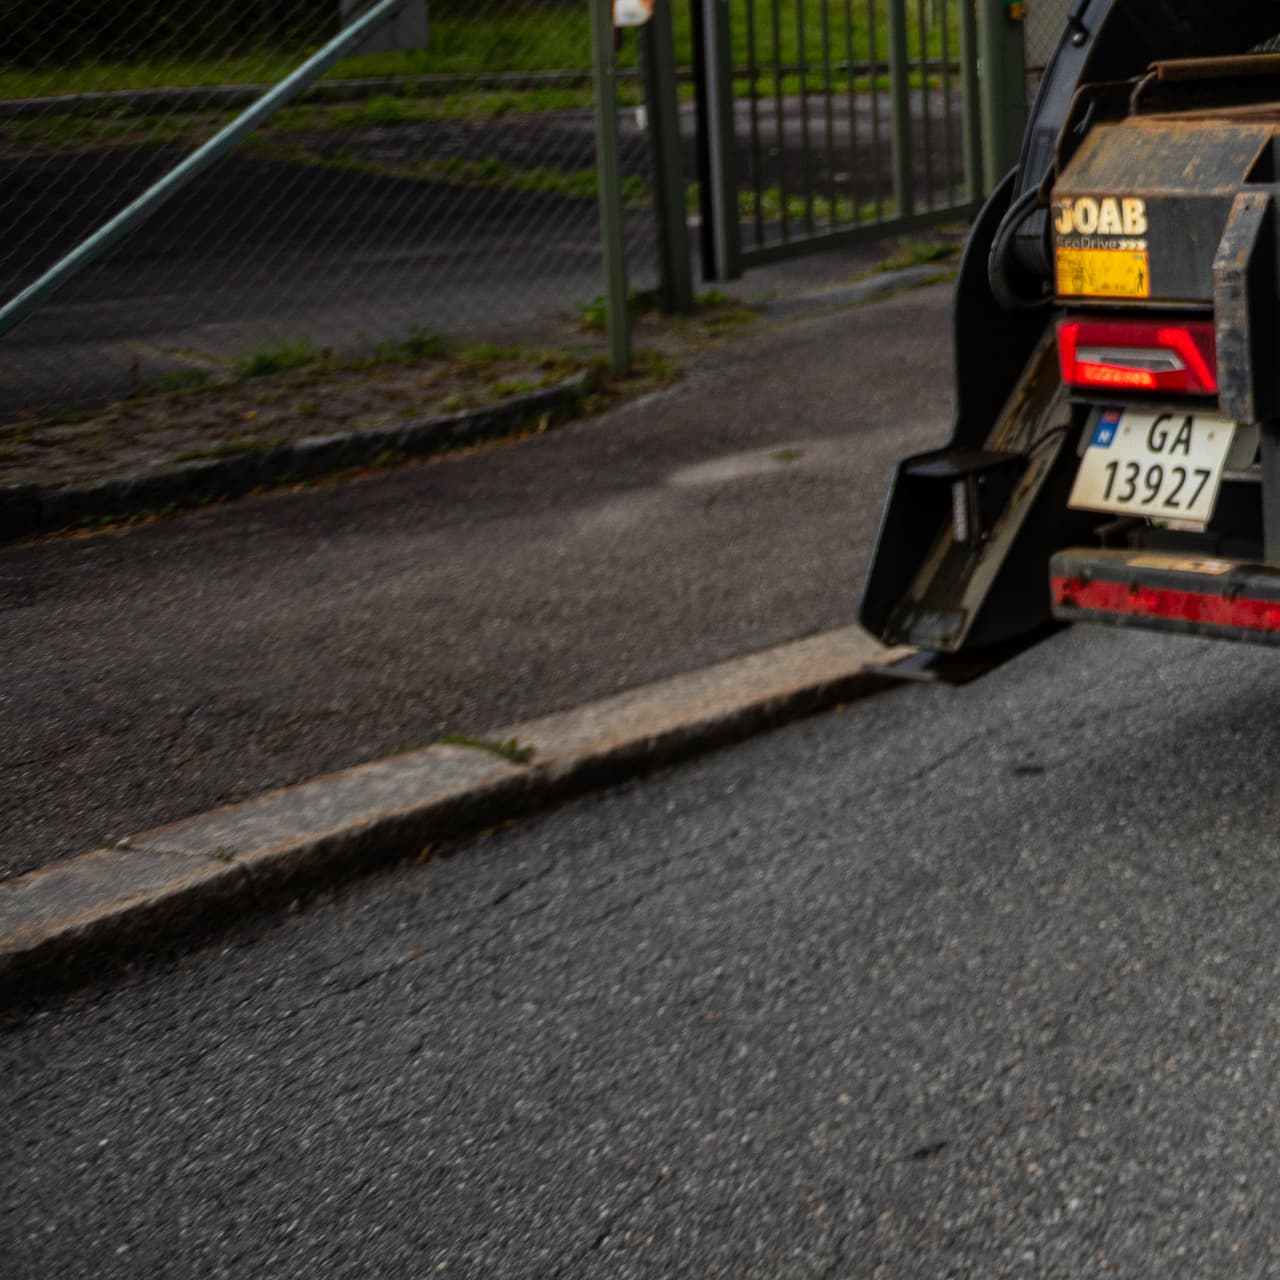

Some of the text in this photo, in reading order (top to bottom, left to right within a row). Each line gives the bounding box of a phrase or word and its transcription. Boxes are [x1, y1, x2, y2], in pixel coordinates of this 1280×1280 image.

[1055, 196, 1147, 235] JOAB
[1146, 413, 1194, 455] GA
[1103, 460, 1211, 510] 13927
